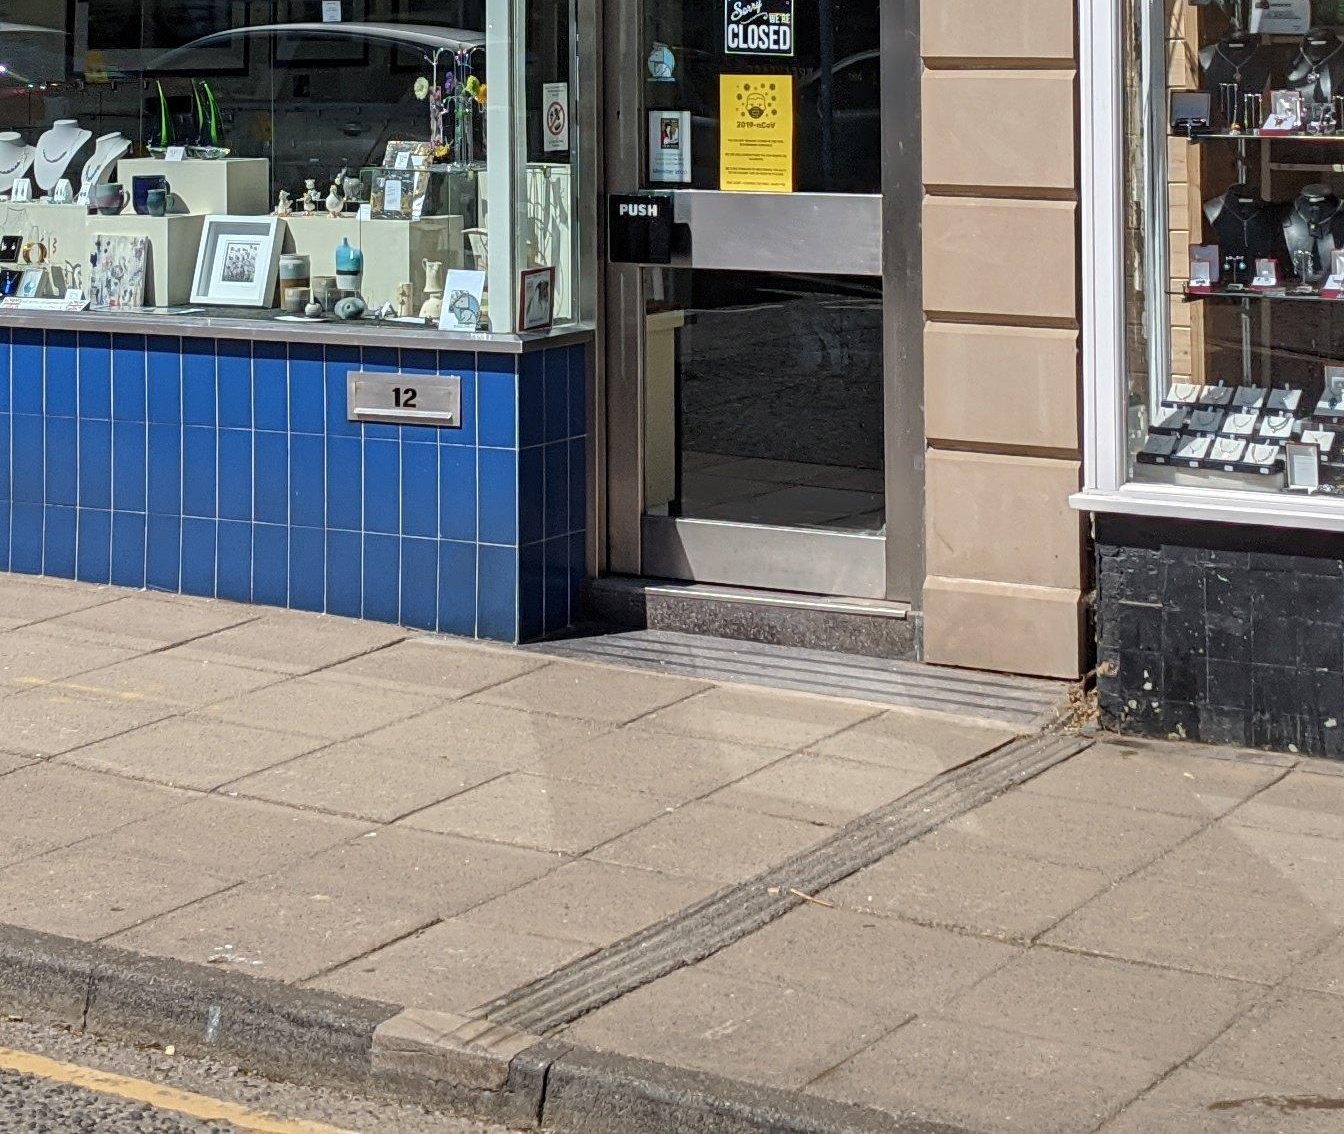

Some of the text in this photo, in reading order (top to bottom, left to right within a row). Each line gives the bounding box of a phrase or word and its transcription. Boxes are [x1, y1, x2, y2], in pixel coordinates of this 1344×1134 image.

[730, 0, 763, 22] Sorry
[727, 23, 791, 50] CLOSED
[619, 203, 658, 217] PUSH
[392, 387, 418, 408] 12
